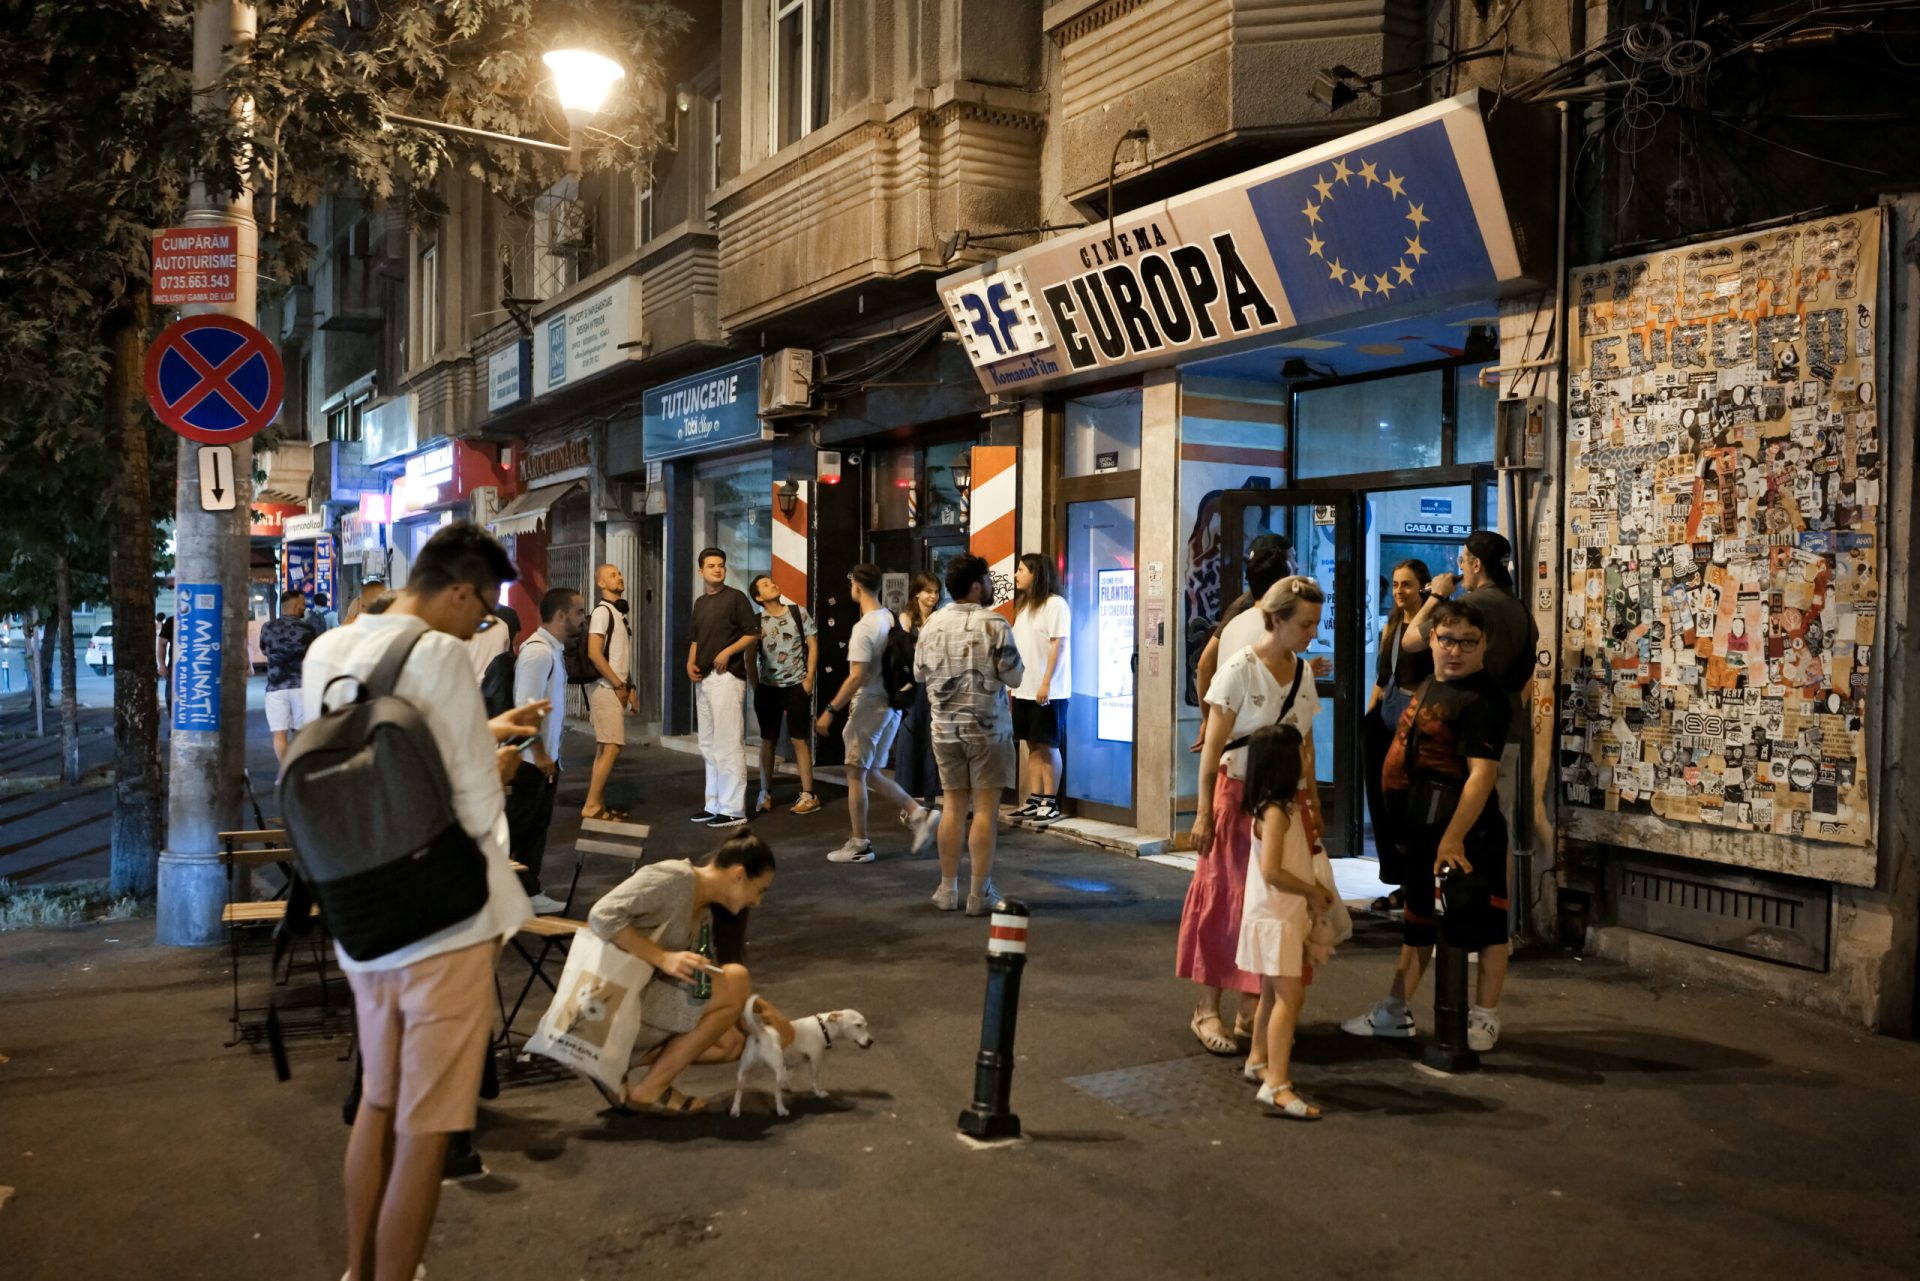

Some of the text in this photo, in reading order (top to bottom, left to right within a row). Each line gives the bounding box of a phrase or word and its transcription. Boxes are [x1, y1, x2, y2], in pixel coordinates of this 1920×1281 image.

[161, 233, 229, 251] CUMPĂRĂM
[1080, 222, 1168, 269] CINEMA
[154, 254, 237, 271] AUTOTURISME
[160, 274, 230, 290] 0735.663.543
[1041, 230, 1281, 372] EUROPA
[661, 374, 738, 421] TUTUNGERIE
[1405, 524, 1433, 533] CASA
[1436, 525, 1449, 533] DE
[178, 666, 189, 724] PALATULUI
